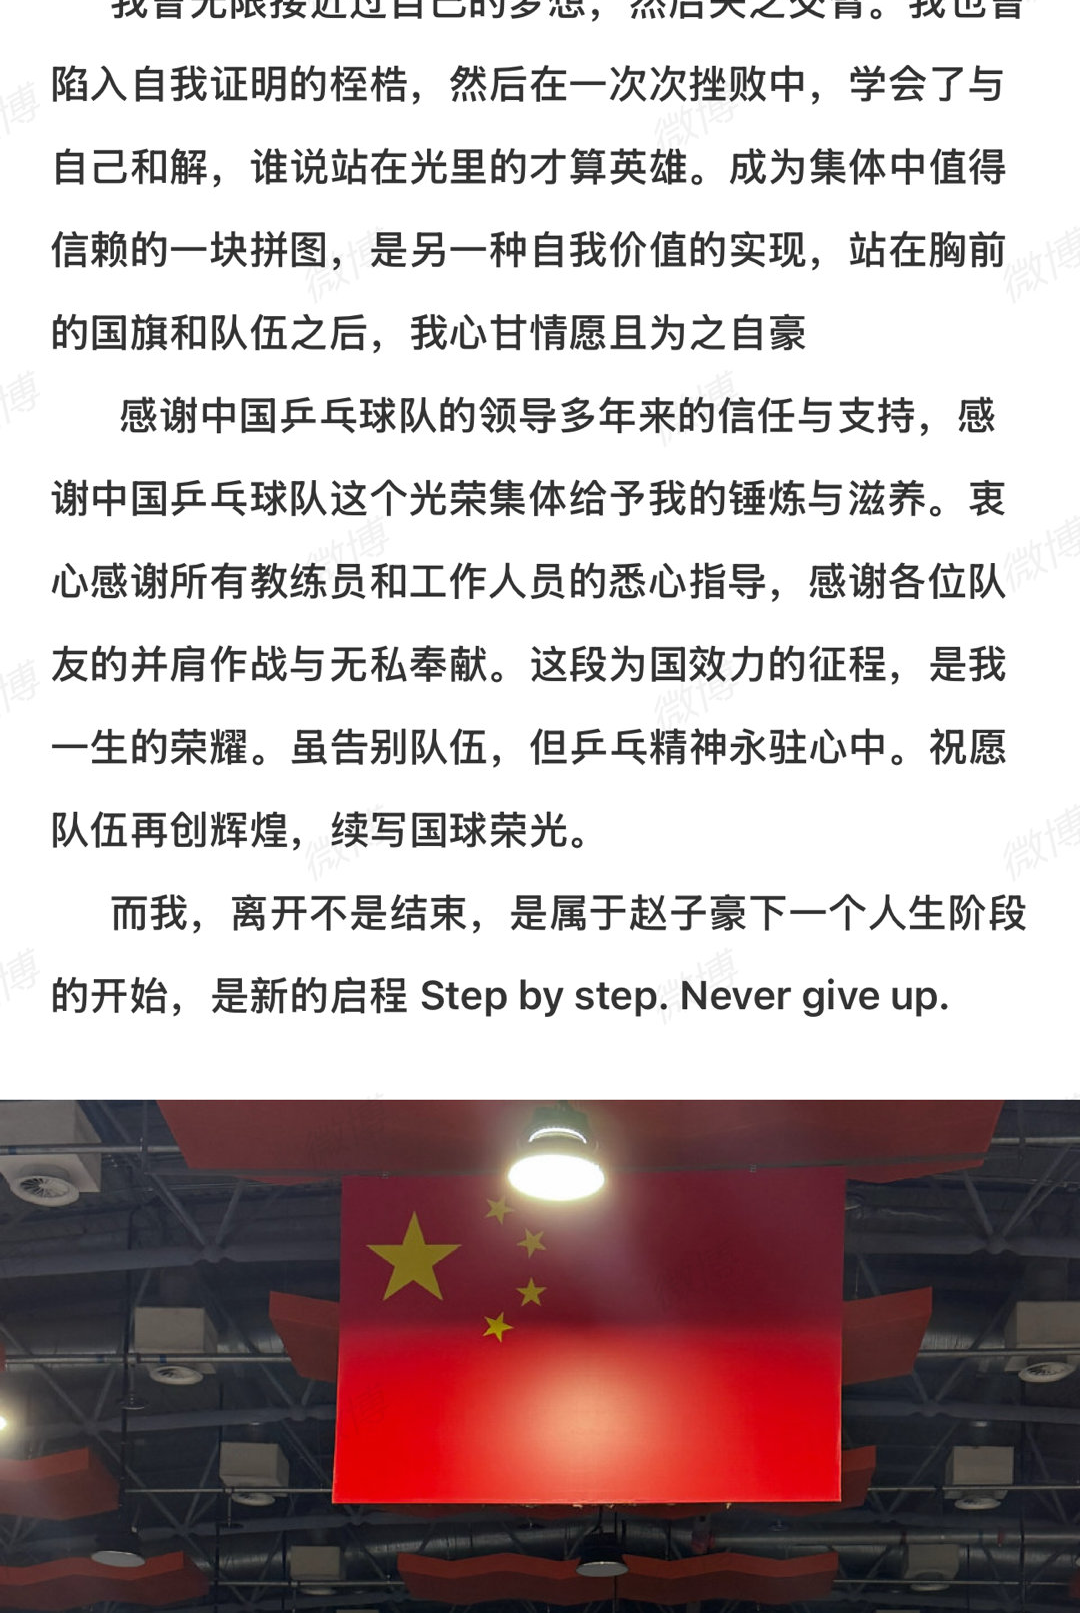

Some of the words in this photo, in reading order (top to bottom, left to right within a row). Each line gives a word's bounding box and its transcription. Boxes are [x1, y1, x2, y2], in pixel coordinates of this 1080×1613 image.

[53, 65, 1003, 105] 陷入自我证明的桎梏，然后在一次次挫败中，学会了与
[56, 148, 1006, 187] 自己和解，谁说站在光里的才算英雄。成为集体中值得
[51, 231, 1005, 270] 信赖的一块拼图，是另一种自我价值的实现，站在胸前
[53, 314, 805, 353] 的国旗和队伍之后，我心甘情愿且为之自豪
[120, 396, 995, 436] 感谢中国乒乓球队的领导多年来的信任与支持，感
[51, 479, 1005, 517] 谢中国乒乓球队这个光荣集体给予我的锤炼与滋养。衷
[52, 562, 1006, 602] 心感谢所有教练员和工作人员的悉心指导，感谢各位队
[52, 645, 1006, 685] 友的并肩作战与无私奉献。这段为国效力的征程，是我
[52, 728, 1006, 768] 一生的荣耀。虽告别队伍，但乒乓精神永驻心中。祝愿
[53, 811, 583, 851] 队伍再创辉煌，续写国球荣光。
[111, 894, 1026, 933] 而我，离开不是结束，是属于赵子豪下一个人生阶段
[53, 977, 407, 1016] 的开始，是新的启程
[422, 980, 507, 1017] Step
[520, 979, 564, 1017] by
[575, 982, 667, 1017] step.
[682, 981, 791, 1010] Never
[803, 978, 879, 1017] give
[892, 987, 948, 1017] up.
